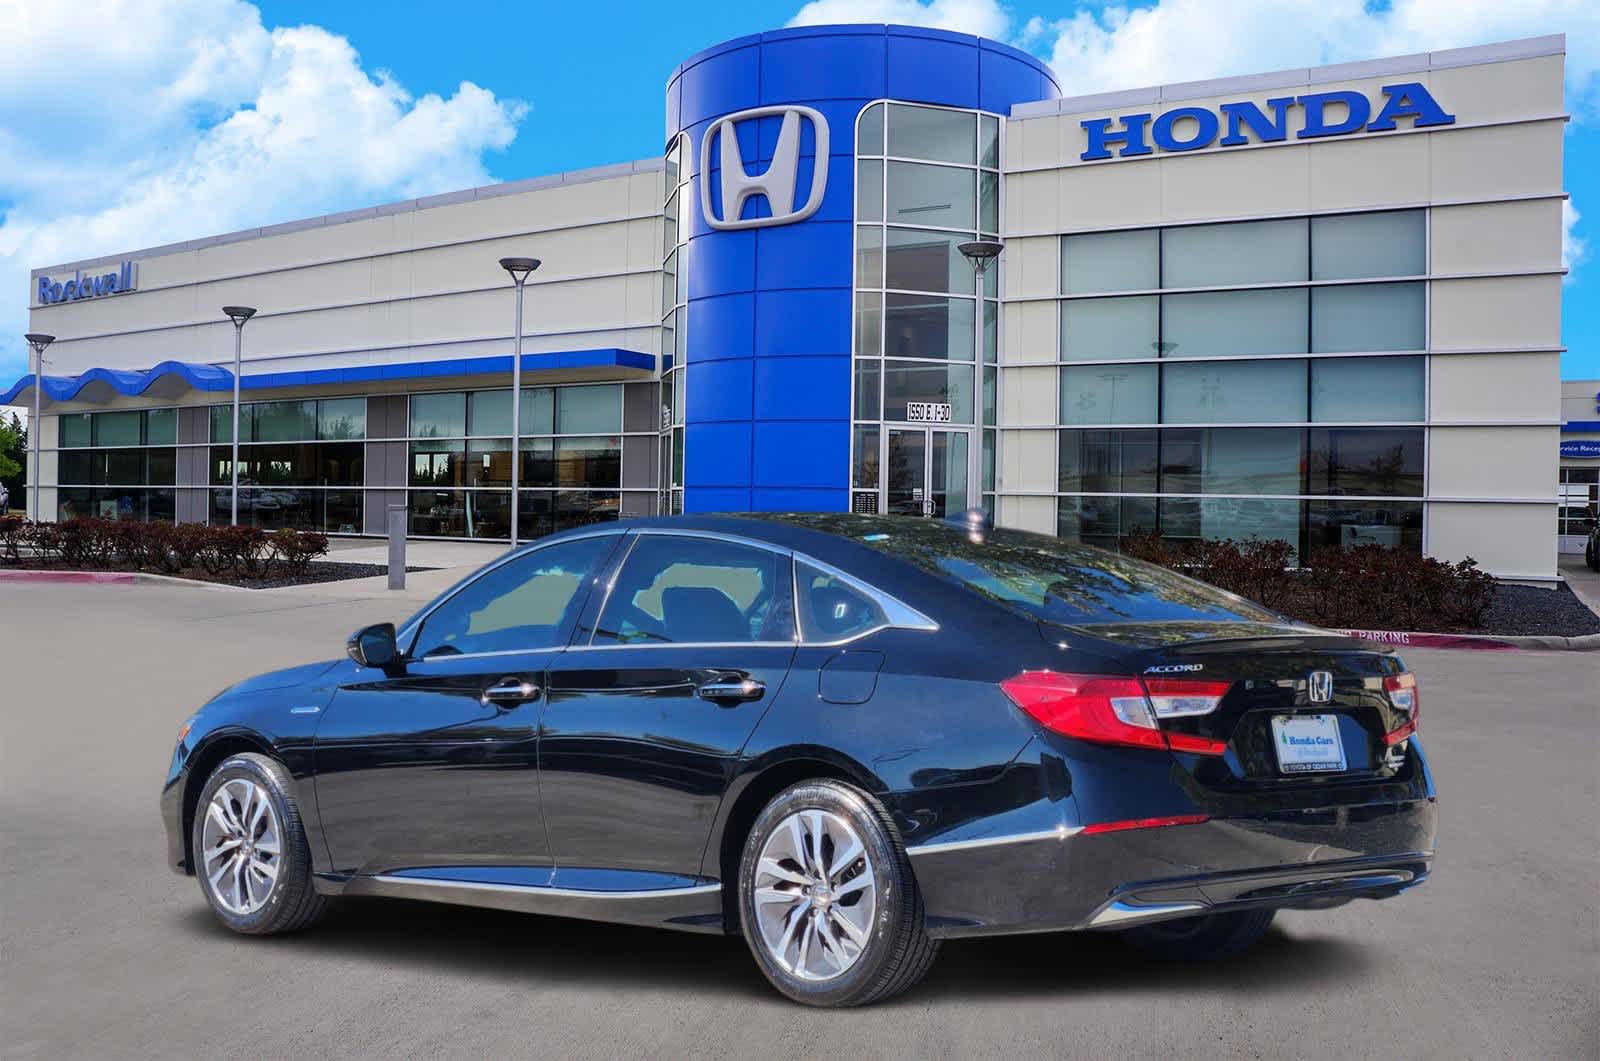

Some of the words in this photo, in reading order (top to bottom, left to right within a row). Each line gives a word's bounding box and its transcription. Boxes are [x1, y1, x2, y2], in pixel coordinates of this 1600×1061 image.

[1080, 82, 1456, 161] HONDA
[38, 260, 132, 304] Rockwall
[1360, 631, 1409, 644] PARKING
[1143, 663, 1204, 675] ACCORD
